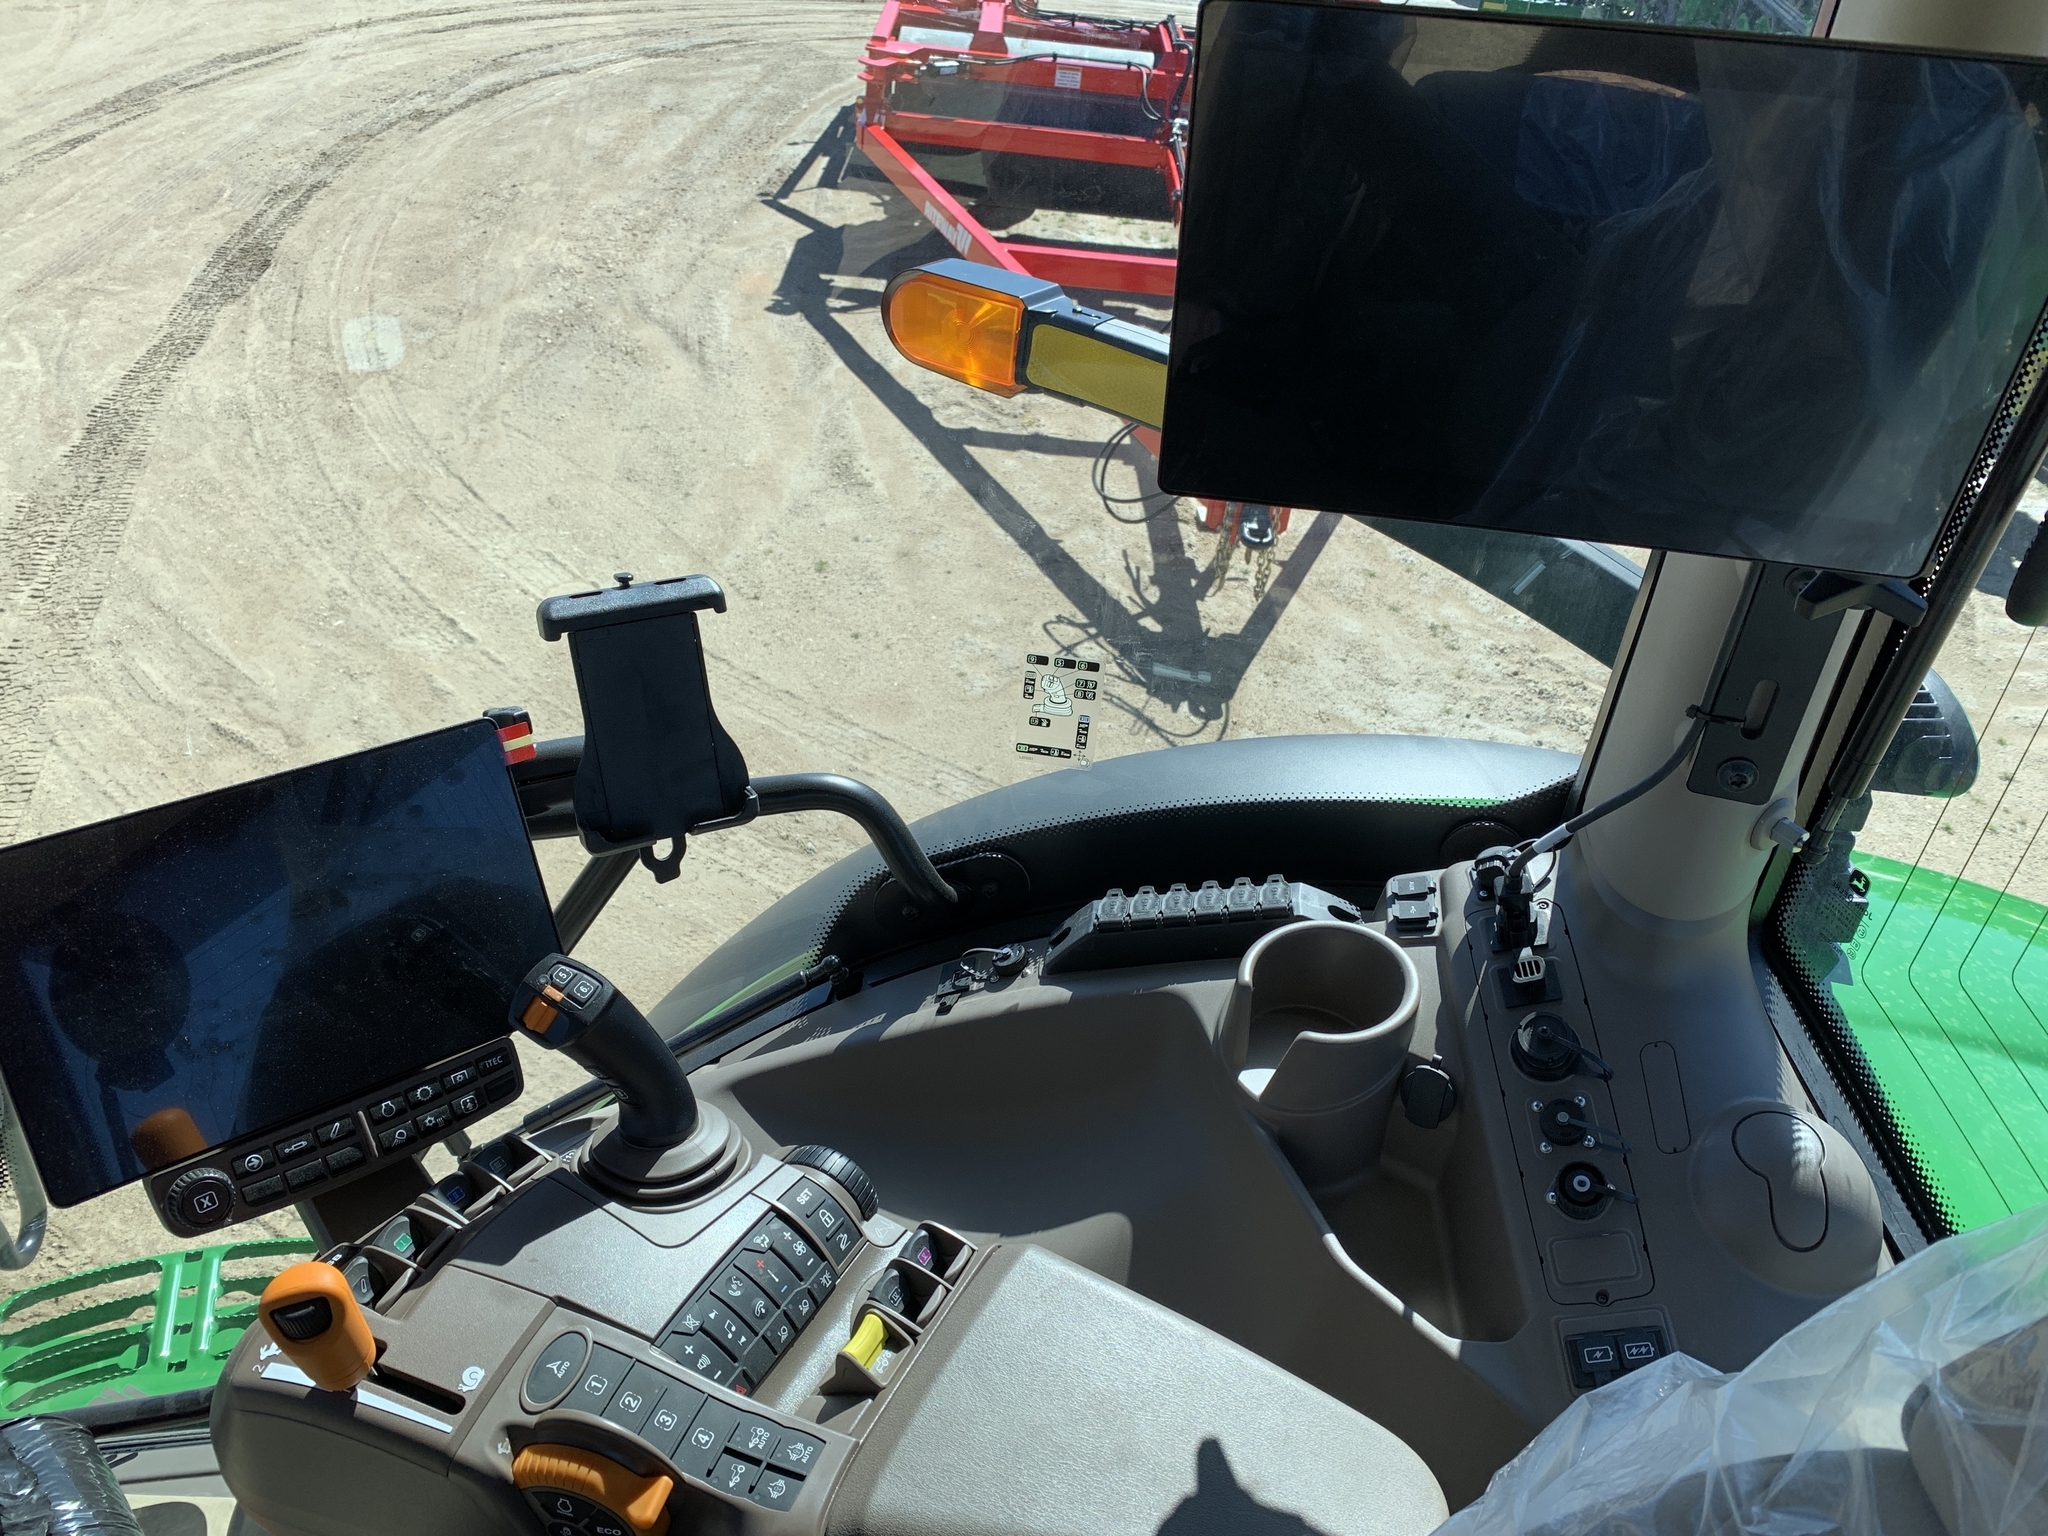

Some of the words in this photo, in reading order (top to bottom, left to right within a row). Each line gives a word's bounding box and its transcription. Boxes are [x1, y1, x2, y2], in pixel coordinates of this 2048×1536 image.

[796, 1187, 813, 1205] SET
[557, 1361, 571, 1379] AUTO
[591, 1380, 602, 1389] 1
[624, 1396, 638, 1408] 2
[659, 1414, 672, 1426] 3
[697, 1433, 710, 1444] 4
[757, 1432, 770, 1450] AUTO
[801, 1446, 814, 1464] AUTO
[596, 1526, 622, 1536] ECO
